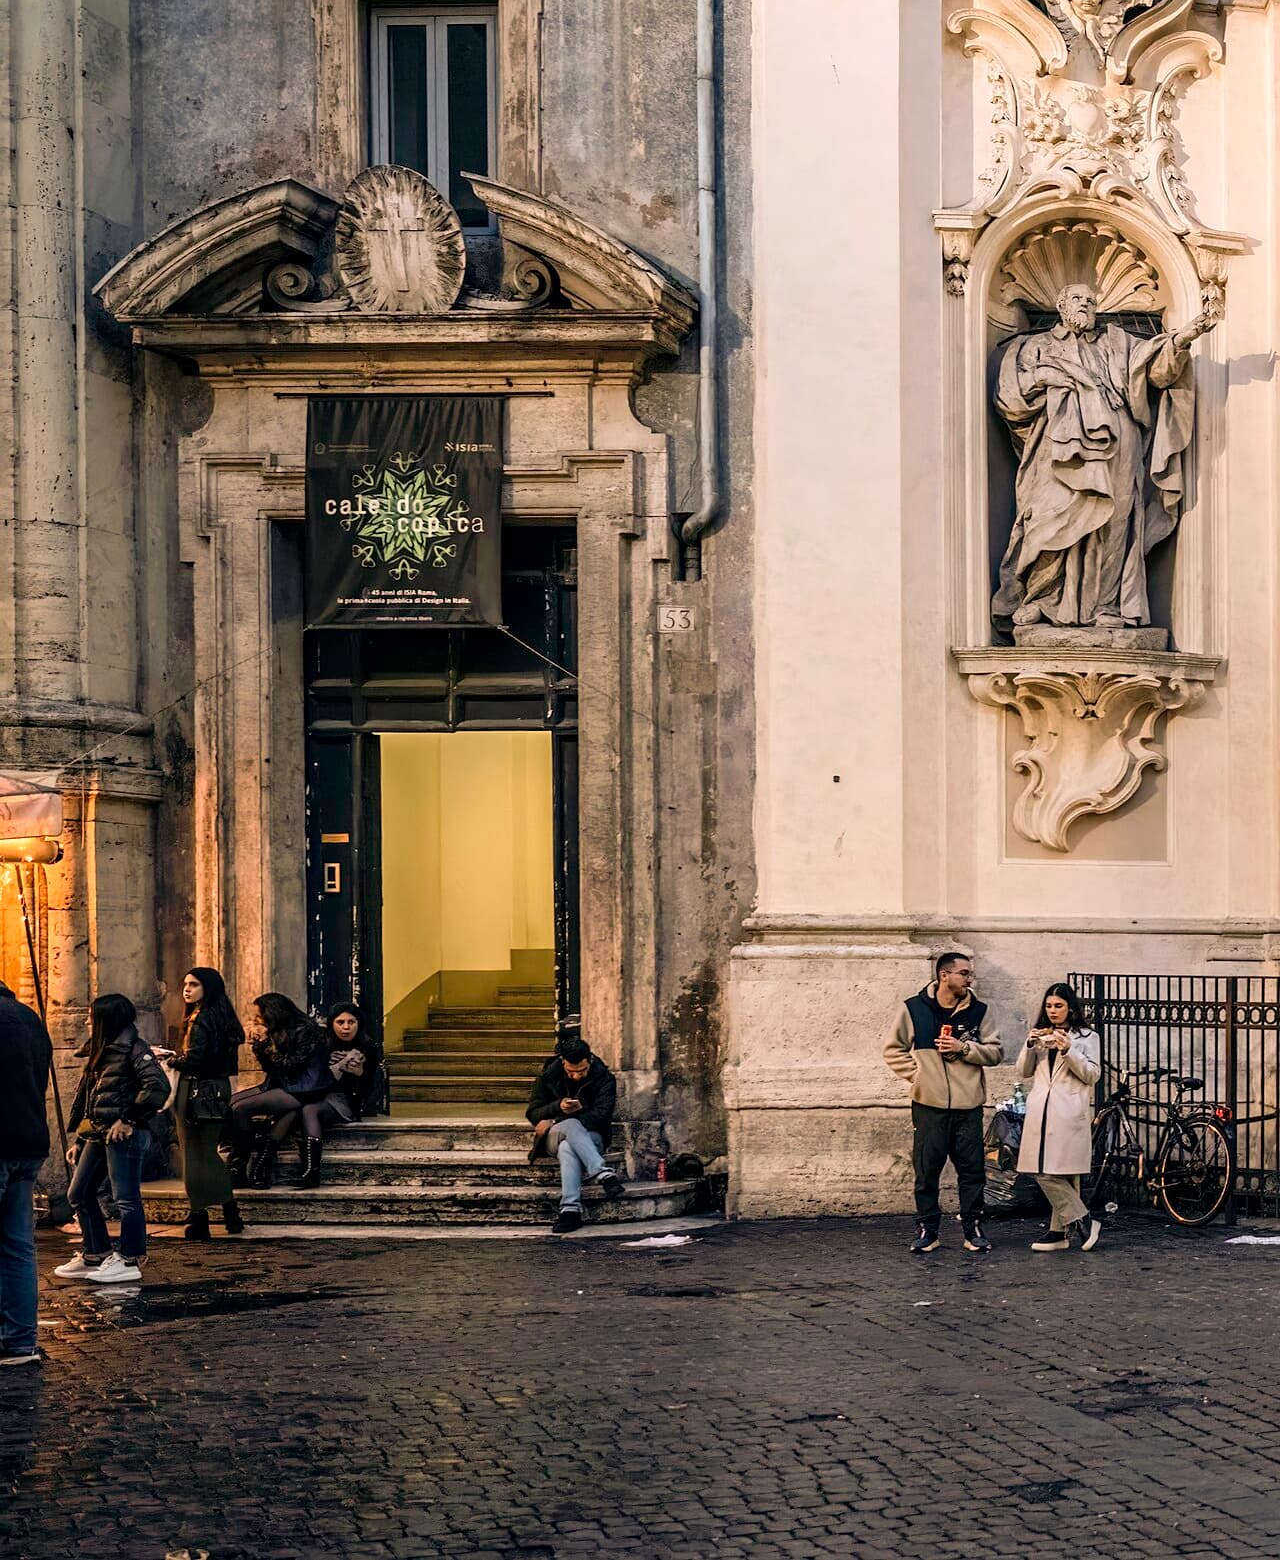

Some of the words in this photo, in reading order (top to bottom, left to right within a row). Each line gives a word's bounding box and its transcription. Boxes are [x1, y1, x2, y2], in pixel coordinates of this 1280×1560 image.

[325, 494, 425, 515] caleido
[383, 515, 484, 538] scopica
[663, 609, 691, 629] 53
